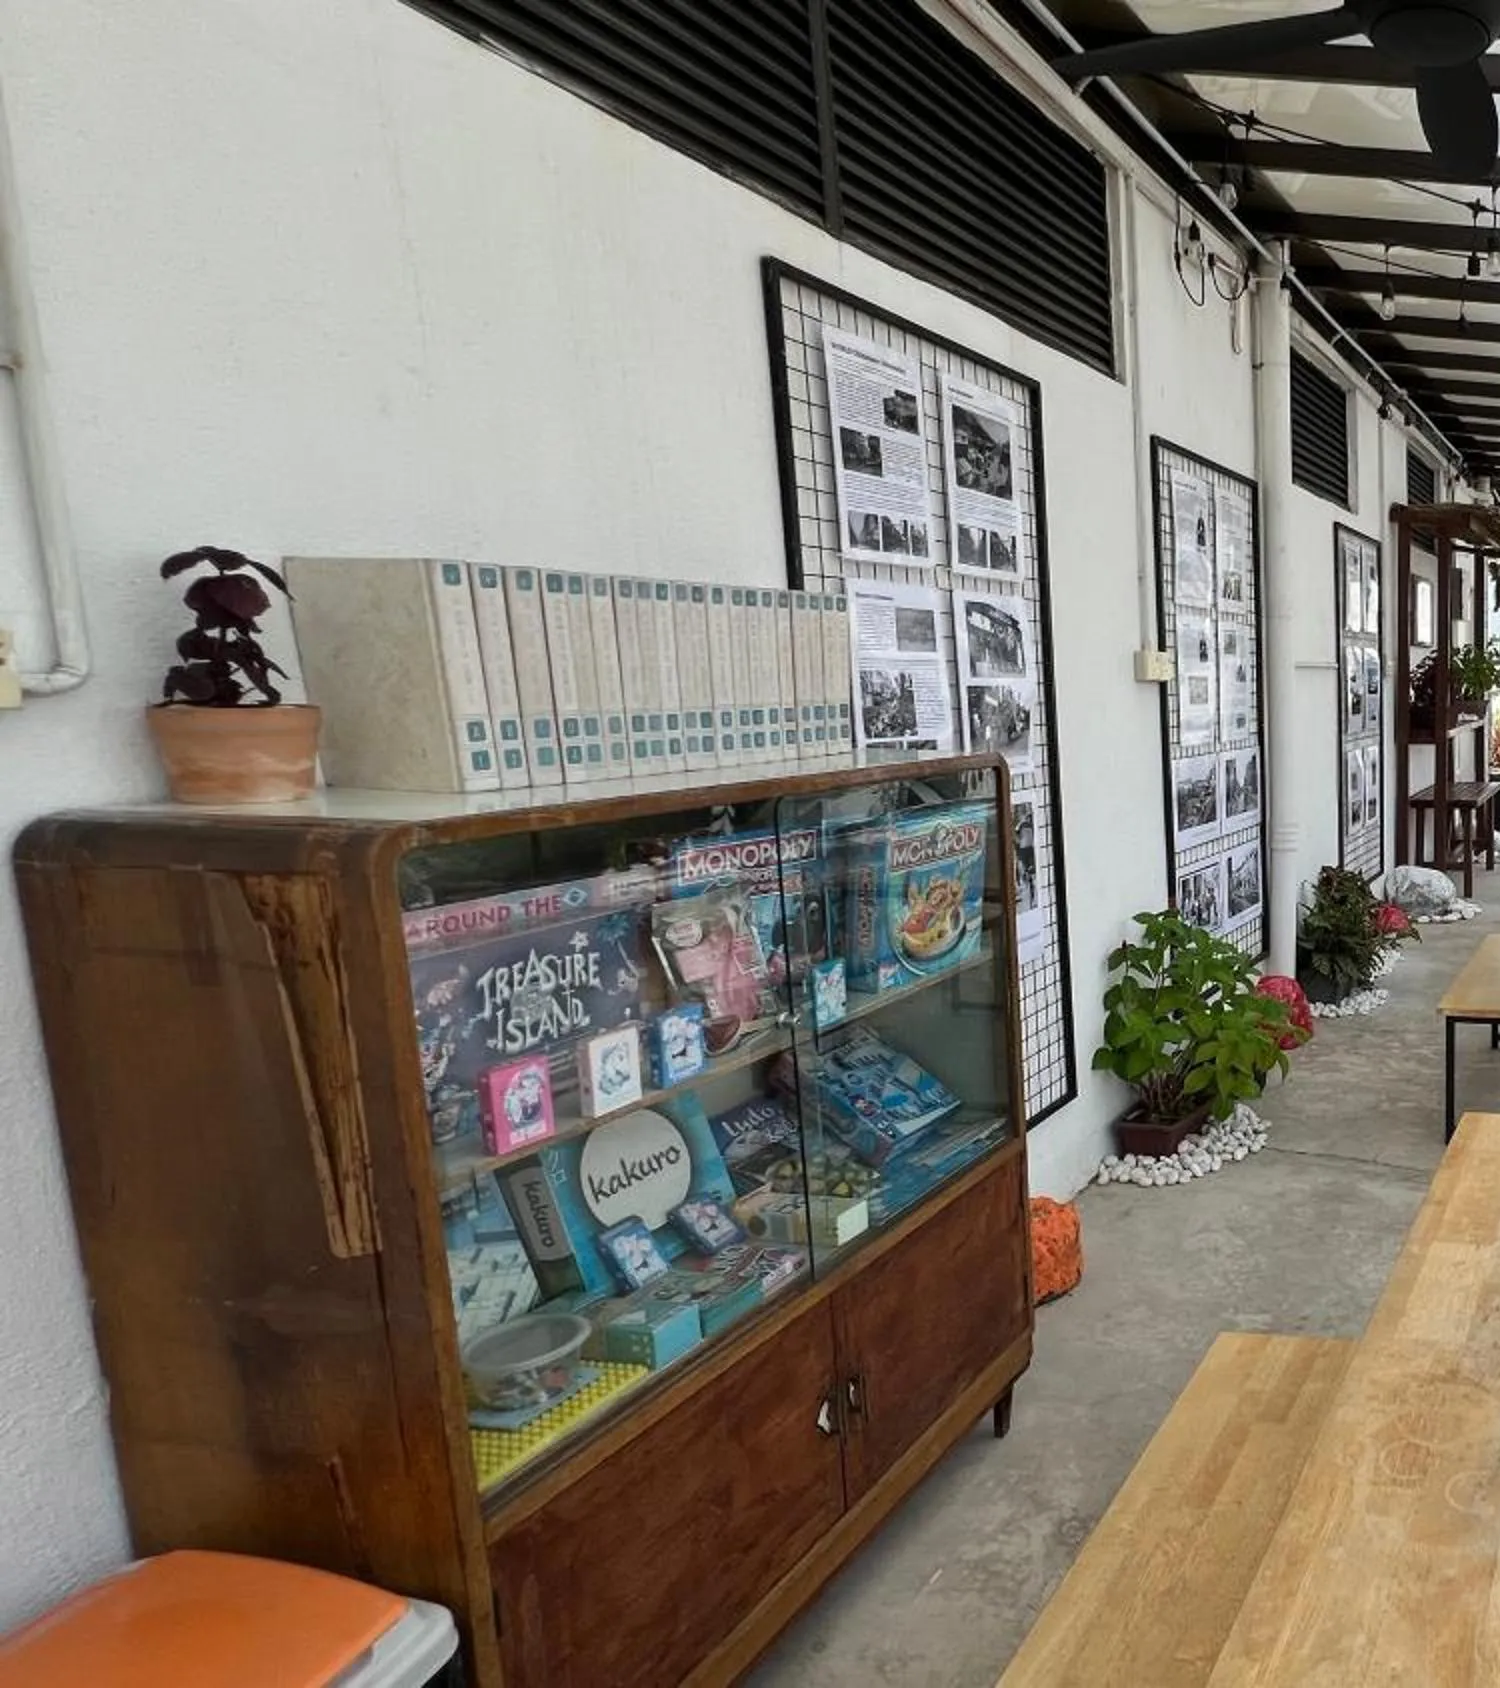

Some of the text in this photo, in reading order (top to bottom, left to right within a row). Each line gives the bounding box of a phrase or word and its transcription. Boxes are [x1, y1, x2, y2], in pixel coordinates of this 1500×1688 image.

[522, 894, 562, 918] THE
[475, 947, 602, 1022] TREASURE
[587, 1144, 682, 1204] kakuro
[521, 1181, 556, 1249] kakuro
